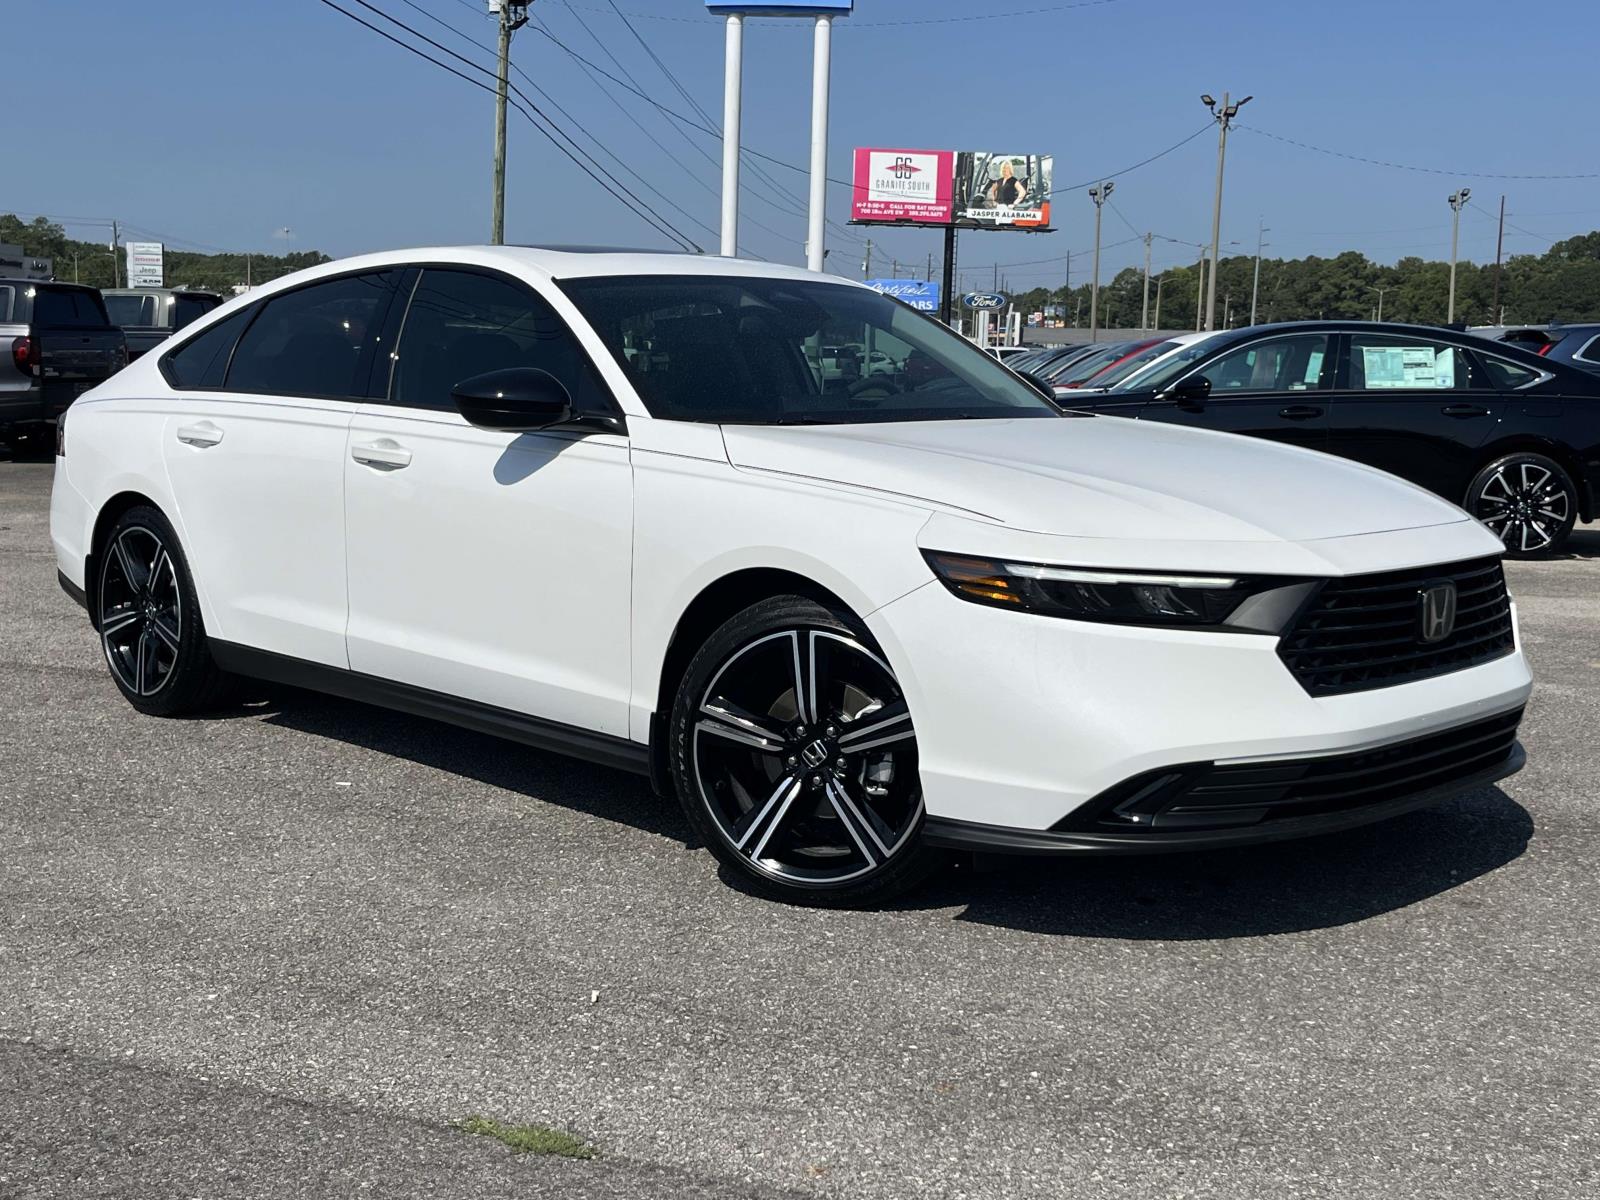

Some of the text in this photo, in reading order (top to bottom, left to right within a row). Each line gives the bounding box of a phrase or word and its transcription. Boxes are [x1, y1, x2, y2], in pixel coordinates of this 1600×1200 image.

[876, 180, 930, 191] GRANITE SOUTH
[1002, 211, 1037, 219] ALABAMA
[971, 295, 998, 307] Ford
